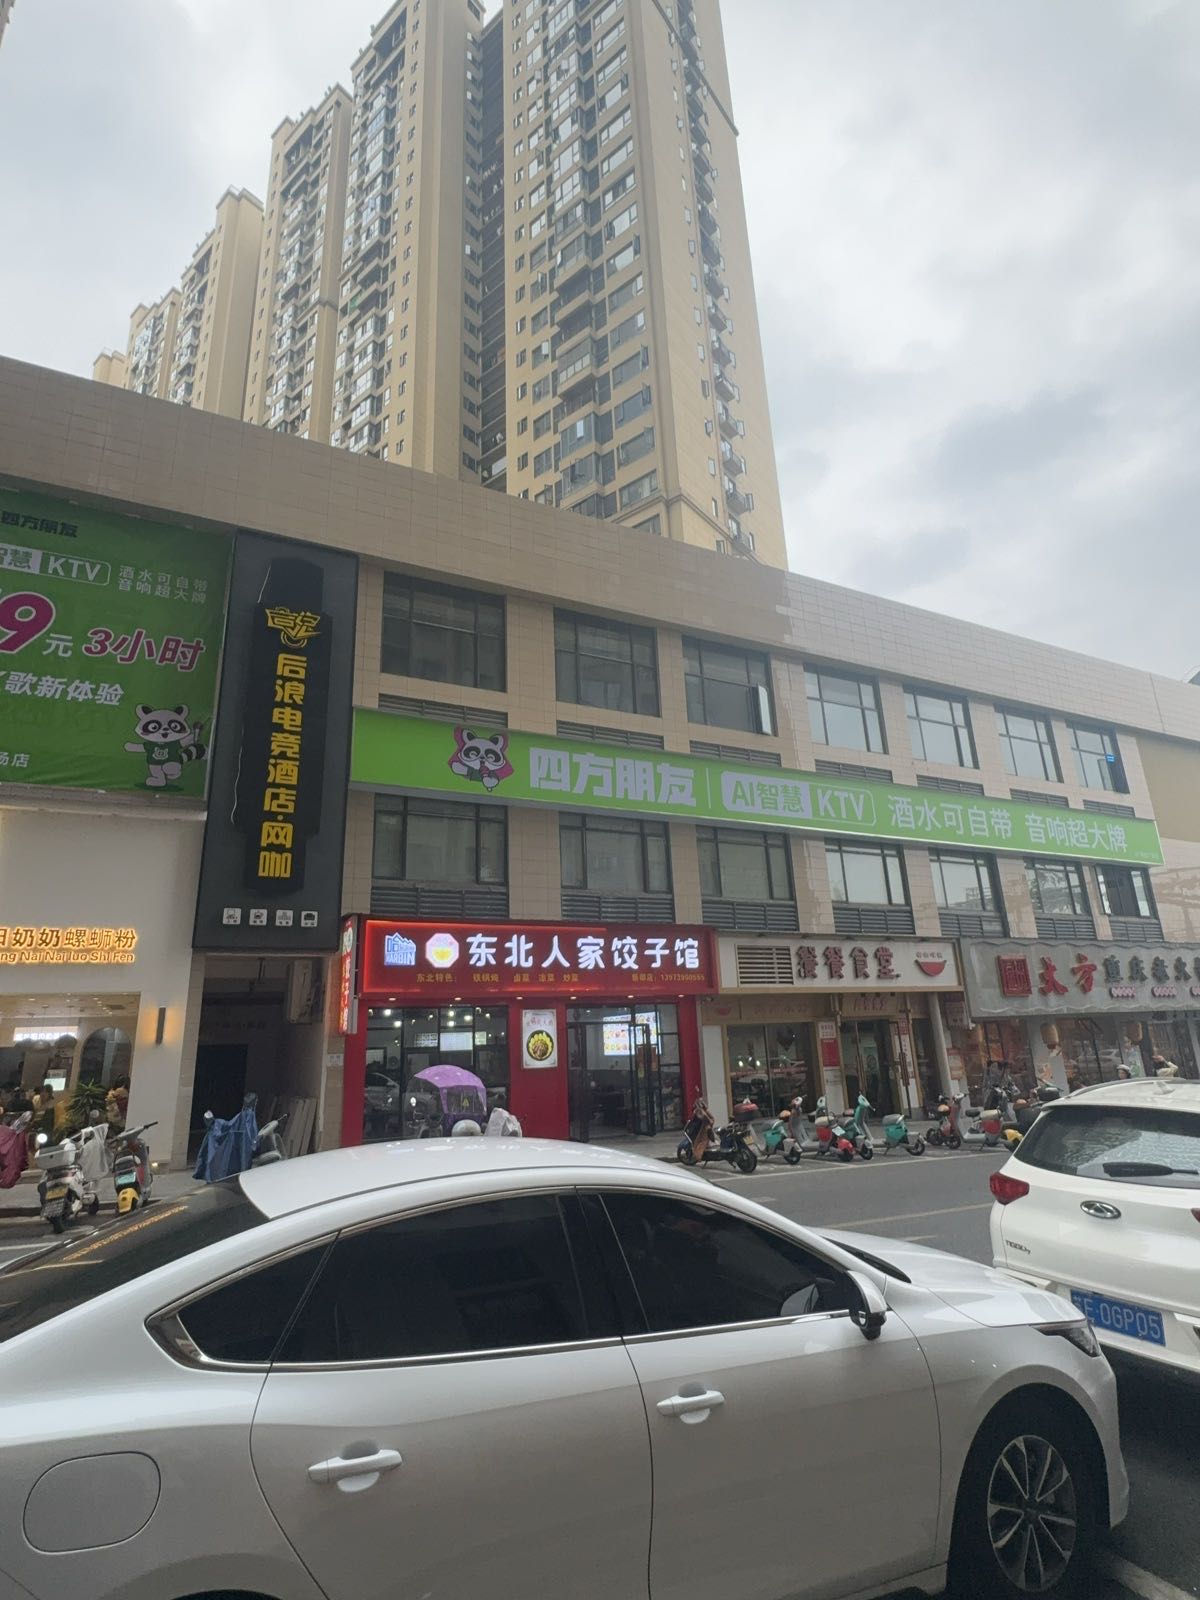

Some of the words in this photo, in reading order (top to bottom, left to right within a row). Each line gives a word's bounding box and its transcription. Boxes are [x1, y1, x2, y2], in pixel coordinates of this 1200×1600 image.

[1, 510, 77, 539] 四方朋友
[48, 558, 102, 582] KTV
[119, 565, 209, 591] 酒水可自带
[118, 578, 208, 604] 音响超大牌
[0, 671, 124, 707] 歌新体验
[528, 746, 697, 808] 四方朋友
[731, 778, 805, 814] AI智慧
[818, 788, 865, 821] KTV
[888, 793, 1013, 839] 酒水可自带
[1025, 813, 1128, 854] 音响超大牌
[90, 951, 111, 962] Shi
[113, 952, 134, 962] Fen
[466, 932, 700, 970] 东北人家饺子馆
